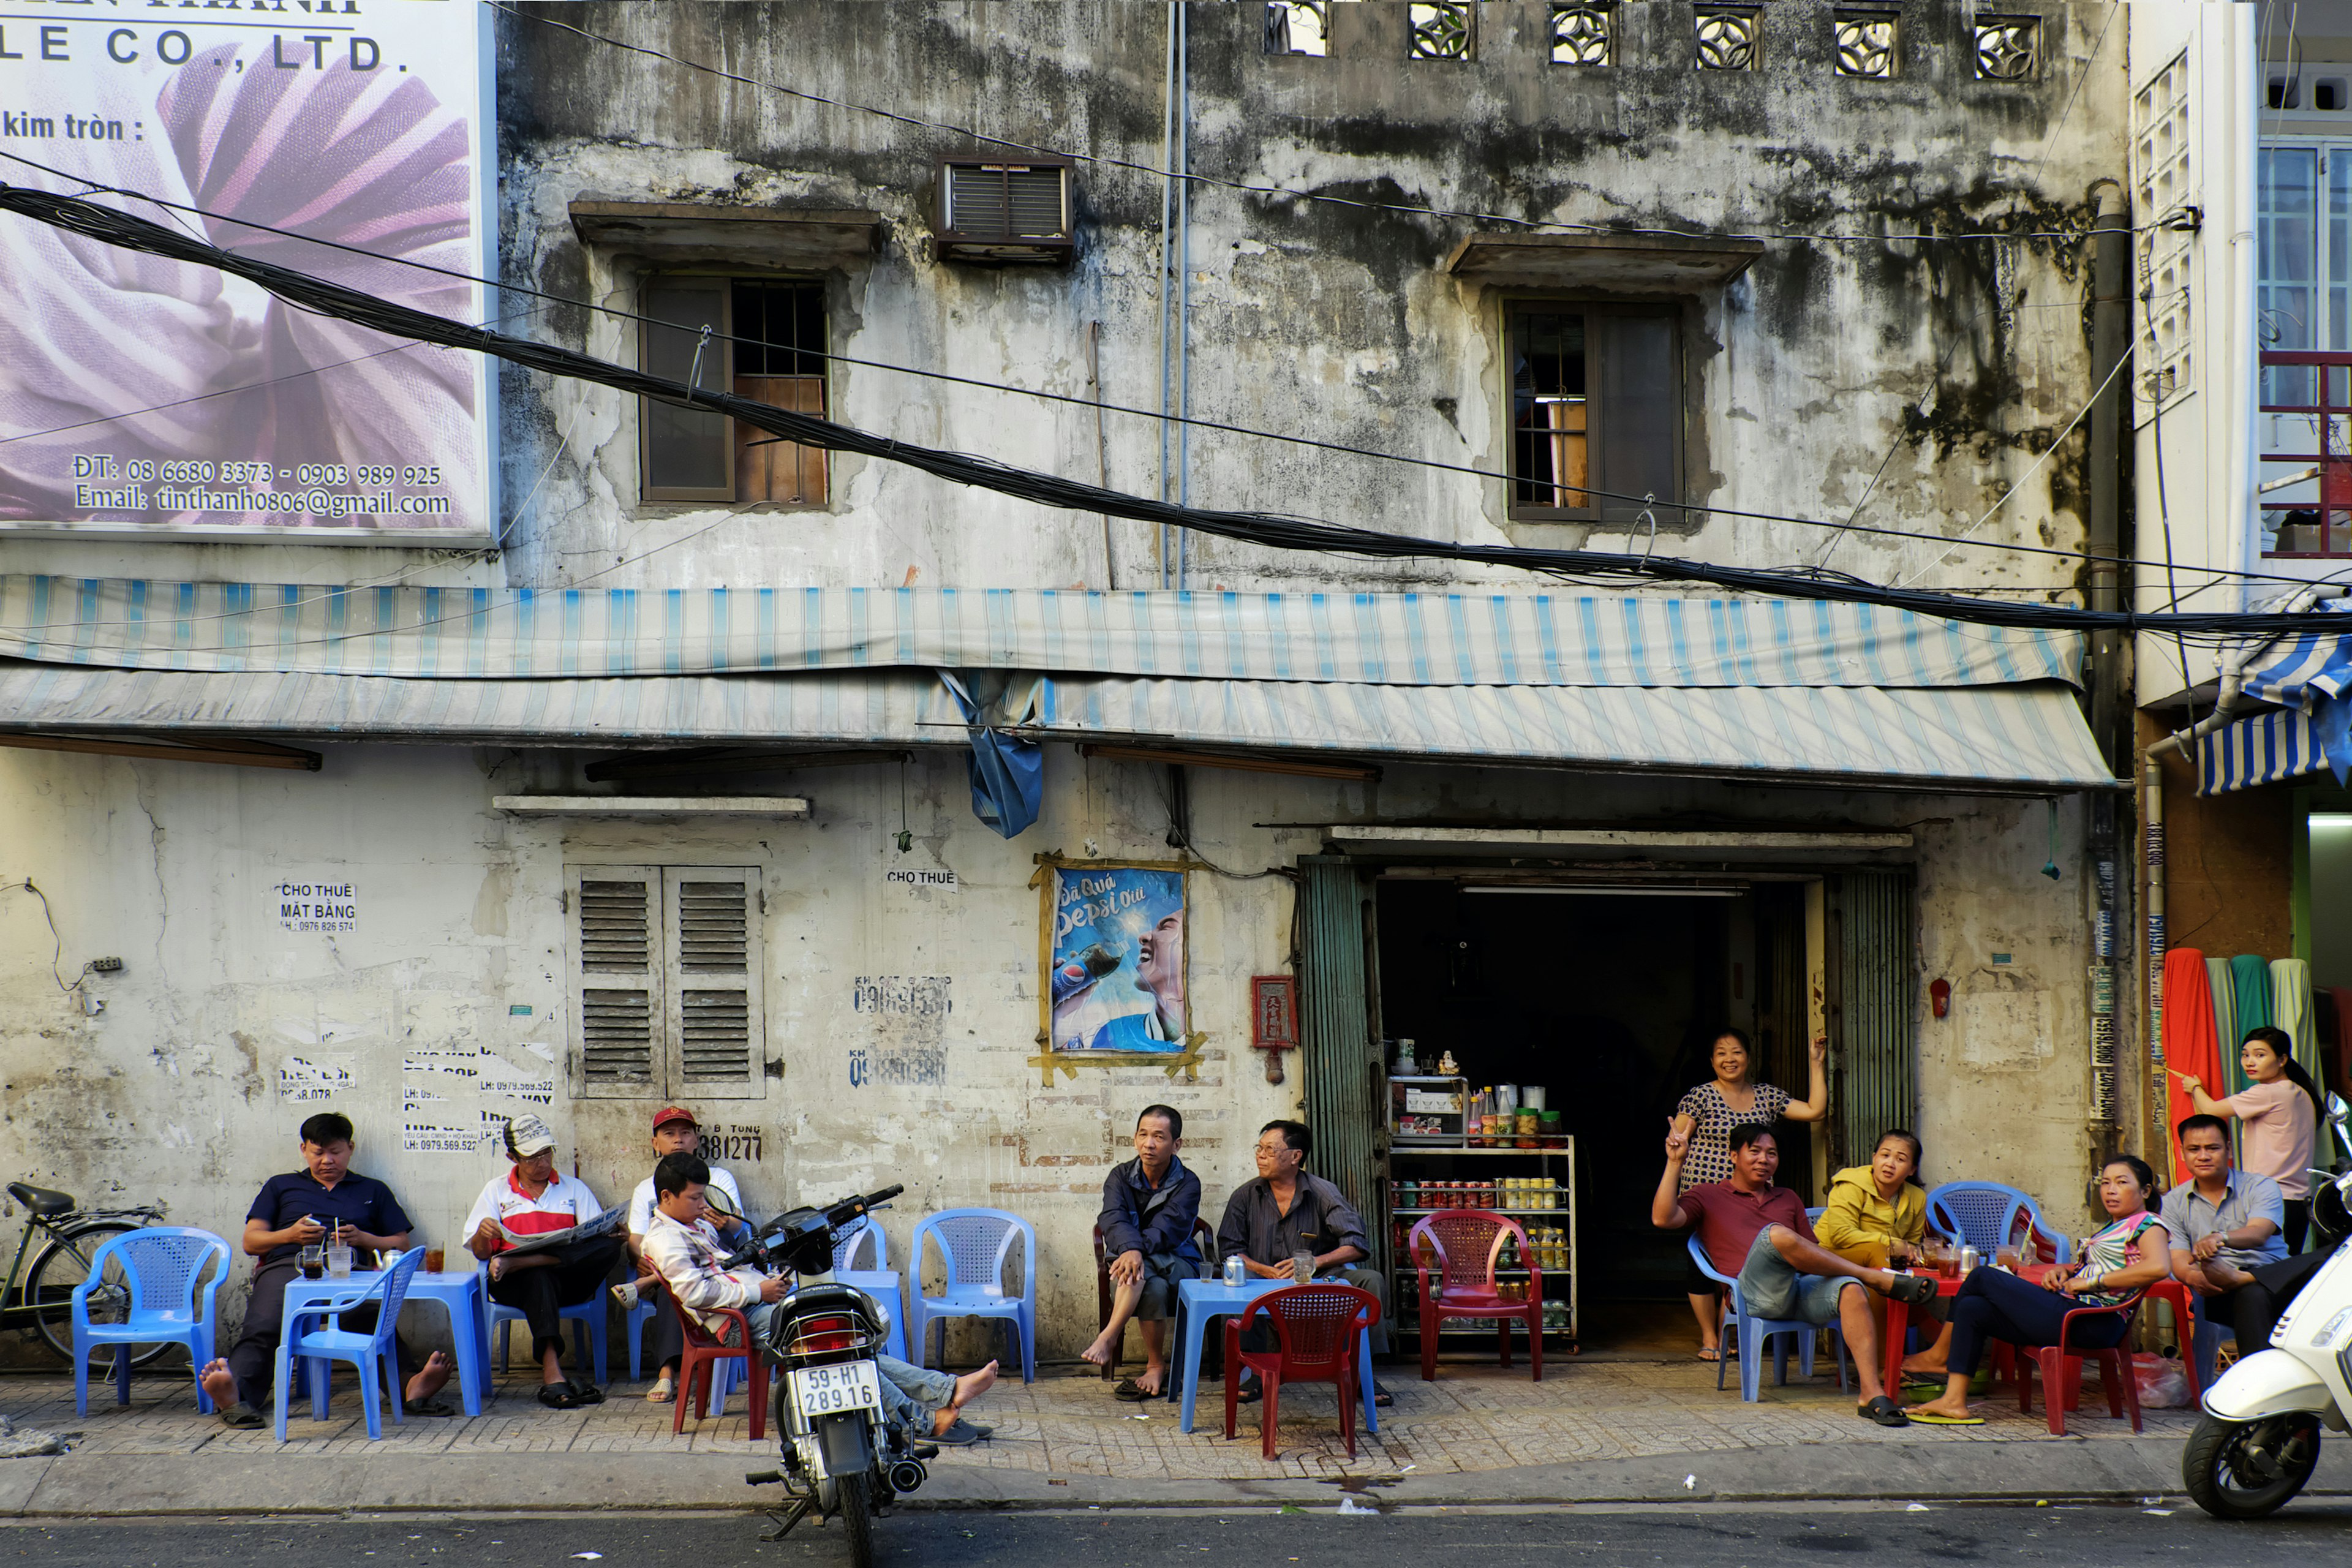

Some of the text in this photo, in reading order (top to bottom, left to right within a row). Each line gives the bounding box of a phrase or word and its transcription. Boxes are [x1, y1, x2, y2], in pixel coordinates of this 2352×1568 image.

[274, 34, 407, 73] LTD.
[4, 111, 54, 138] kim
[65, 113, 123, 140] tròn
[72, 455, 119, 480] ĐT:
[127, 461, 154, 481] 08
[162, 461, 214, 481] 6680
[222, 463, 273, 483] 3373
[298, 464, 349, 485] 0903
[357, 466, 396, 486] 989
[403, 467, 441, 486] 925
[75, 484, 450, 516] Email: tinthanh0806@gmail.com
[888, 870, 954, 883] CHO THUÊ
[281, 883, 352, 897] CHO THUÊ
[281, 899, 355, 920] MẶT BẰNG
[300, 921, 319, 931] 0976
[322, 922, 336, 931] 826
[339, 922, 353, 931] 574
[2097, 1018, 2114, 1063] 0908761553
[404, 1088, 418, 1098] LH:
[480, 1080, 553, 1091] LH: 0979.569.522
[404, 1140, 477, 1151] LH: 0979.569.522
[808, 1365, 860, 1390] 59-H1
[805, 1385, 873, 1412] 289.16
